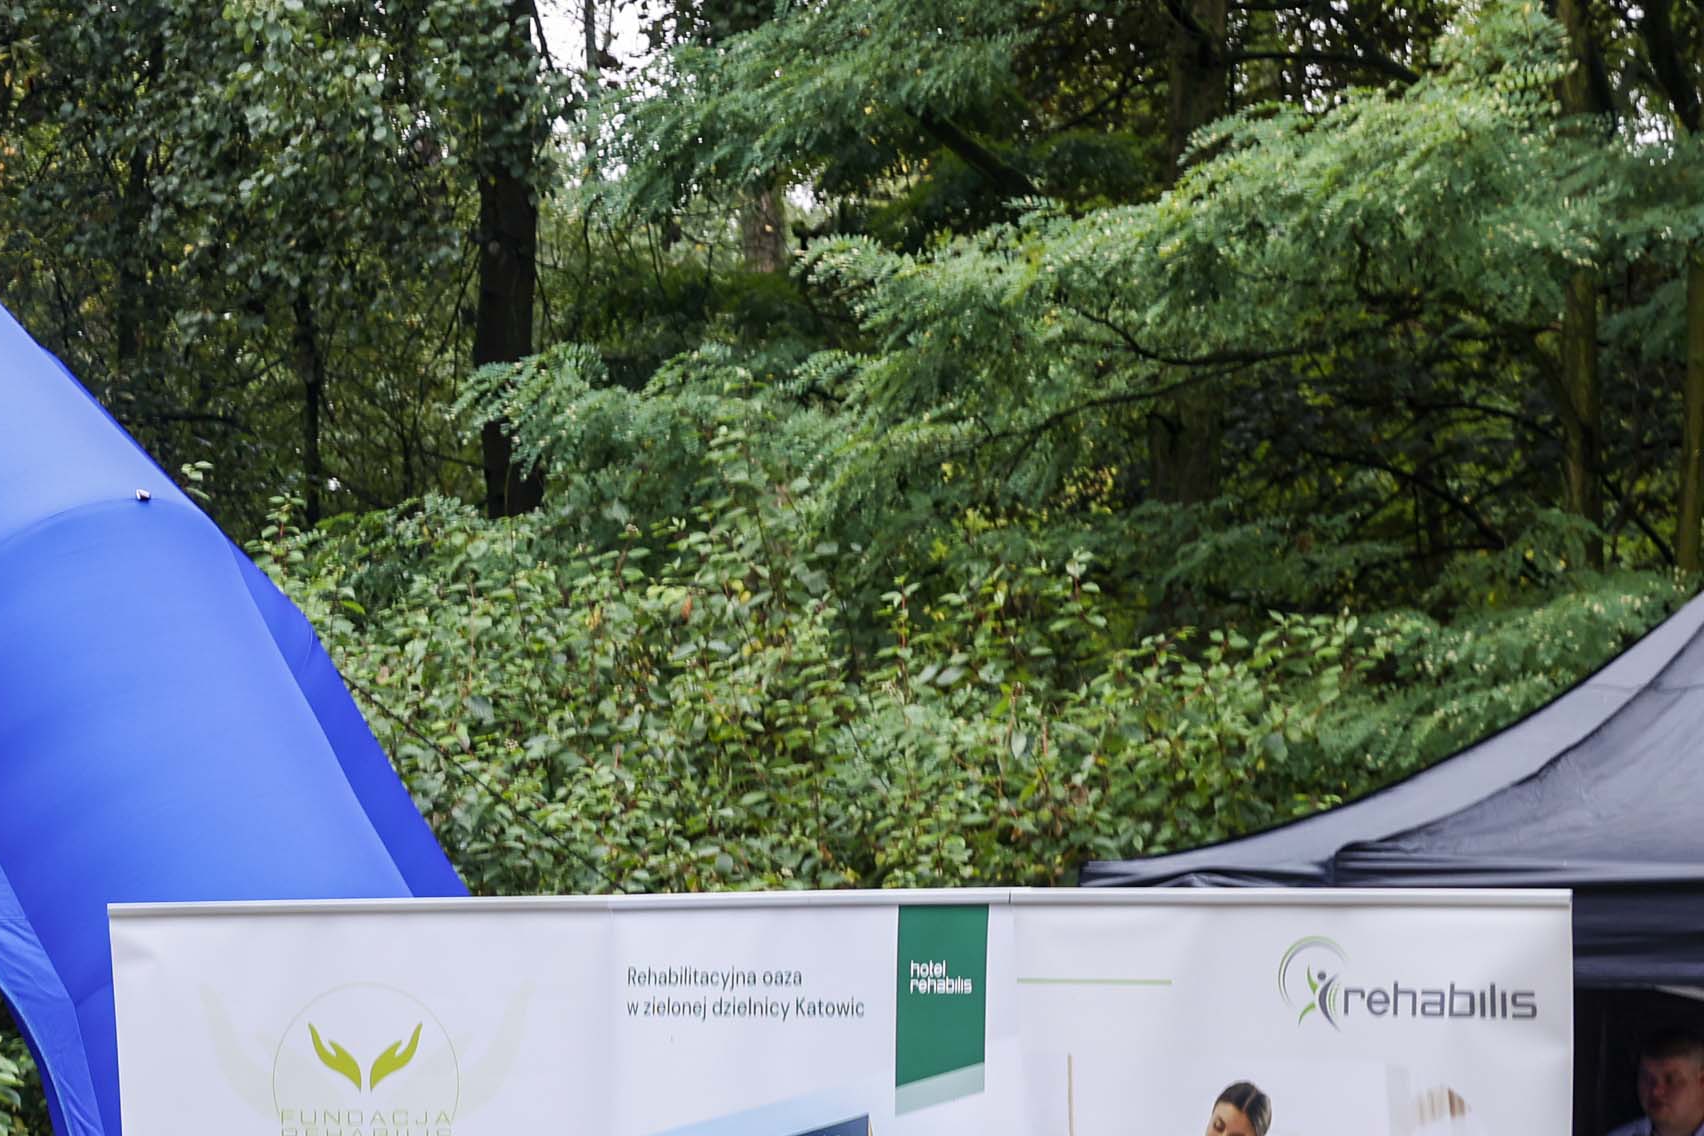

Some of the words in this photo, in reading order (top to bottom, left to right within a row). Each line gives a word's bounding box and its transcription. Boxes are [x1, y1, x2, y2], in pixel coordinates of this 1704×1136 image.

[626, 966, 756, 990] Rehabilitacyjna
[761, 972, 802, 985] oaza
[909, 960, 946, 977] hotel
[909, 976, 972, 994] rehabilis
[625, 1001, 639, 1016] w
[642, 997, 706, 1021] zielonej
[711, 997, 789, 1021] dzielnicy
[794, 998, 864, 1016] Katowic
[1342, 981, 1537, 1018] rehabilis
[279, 1109, 452, 1126] FUNDACJA
